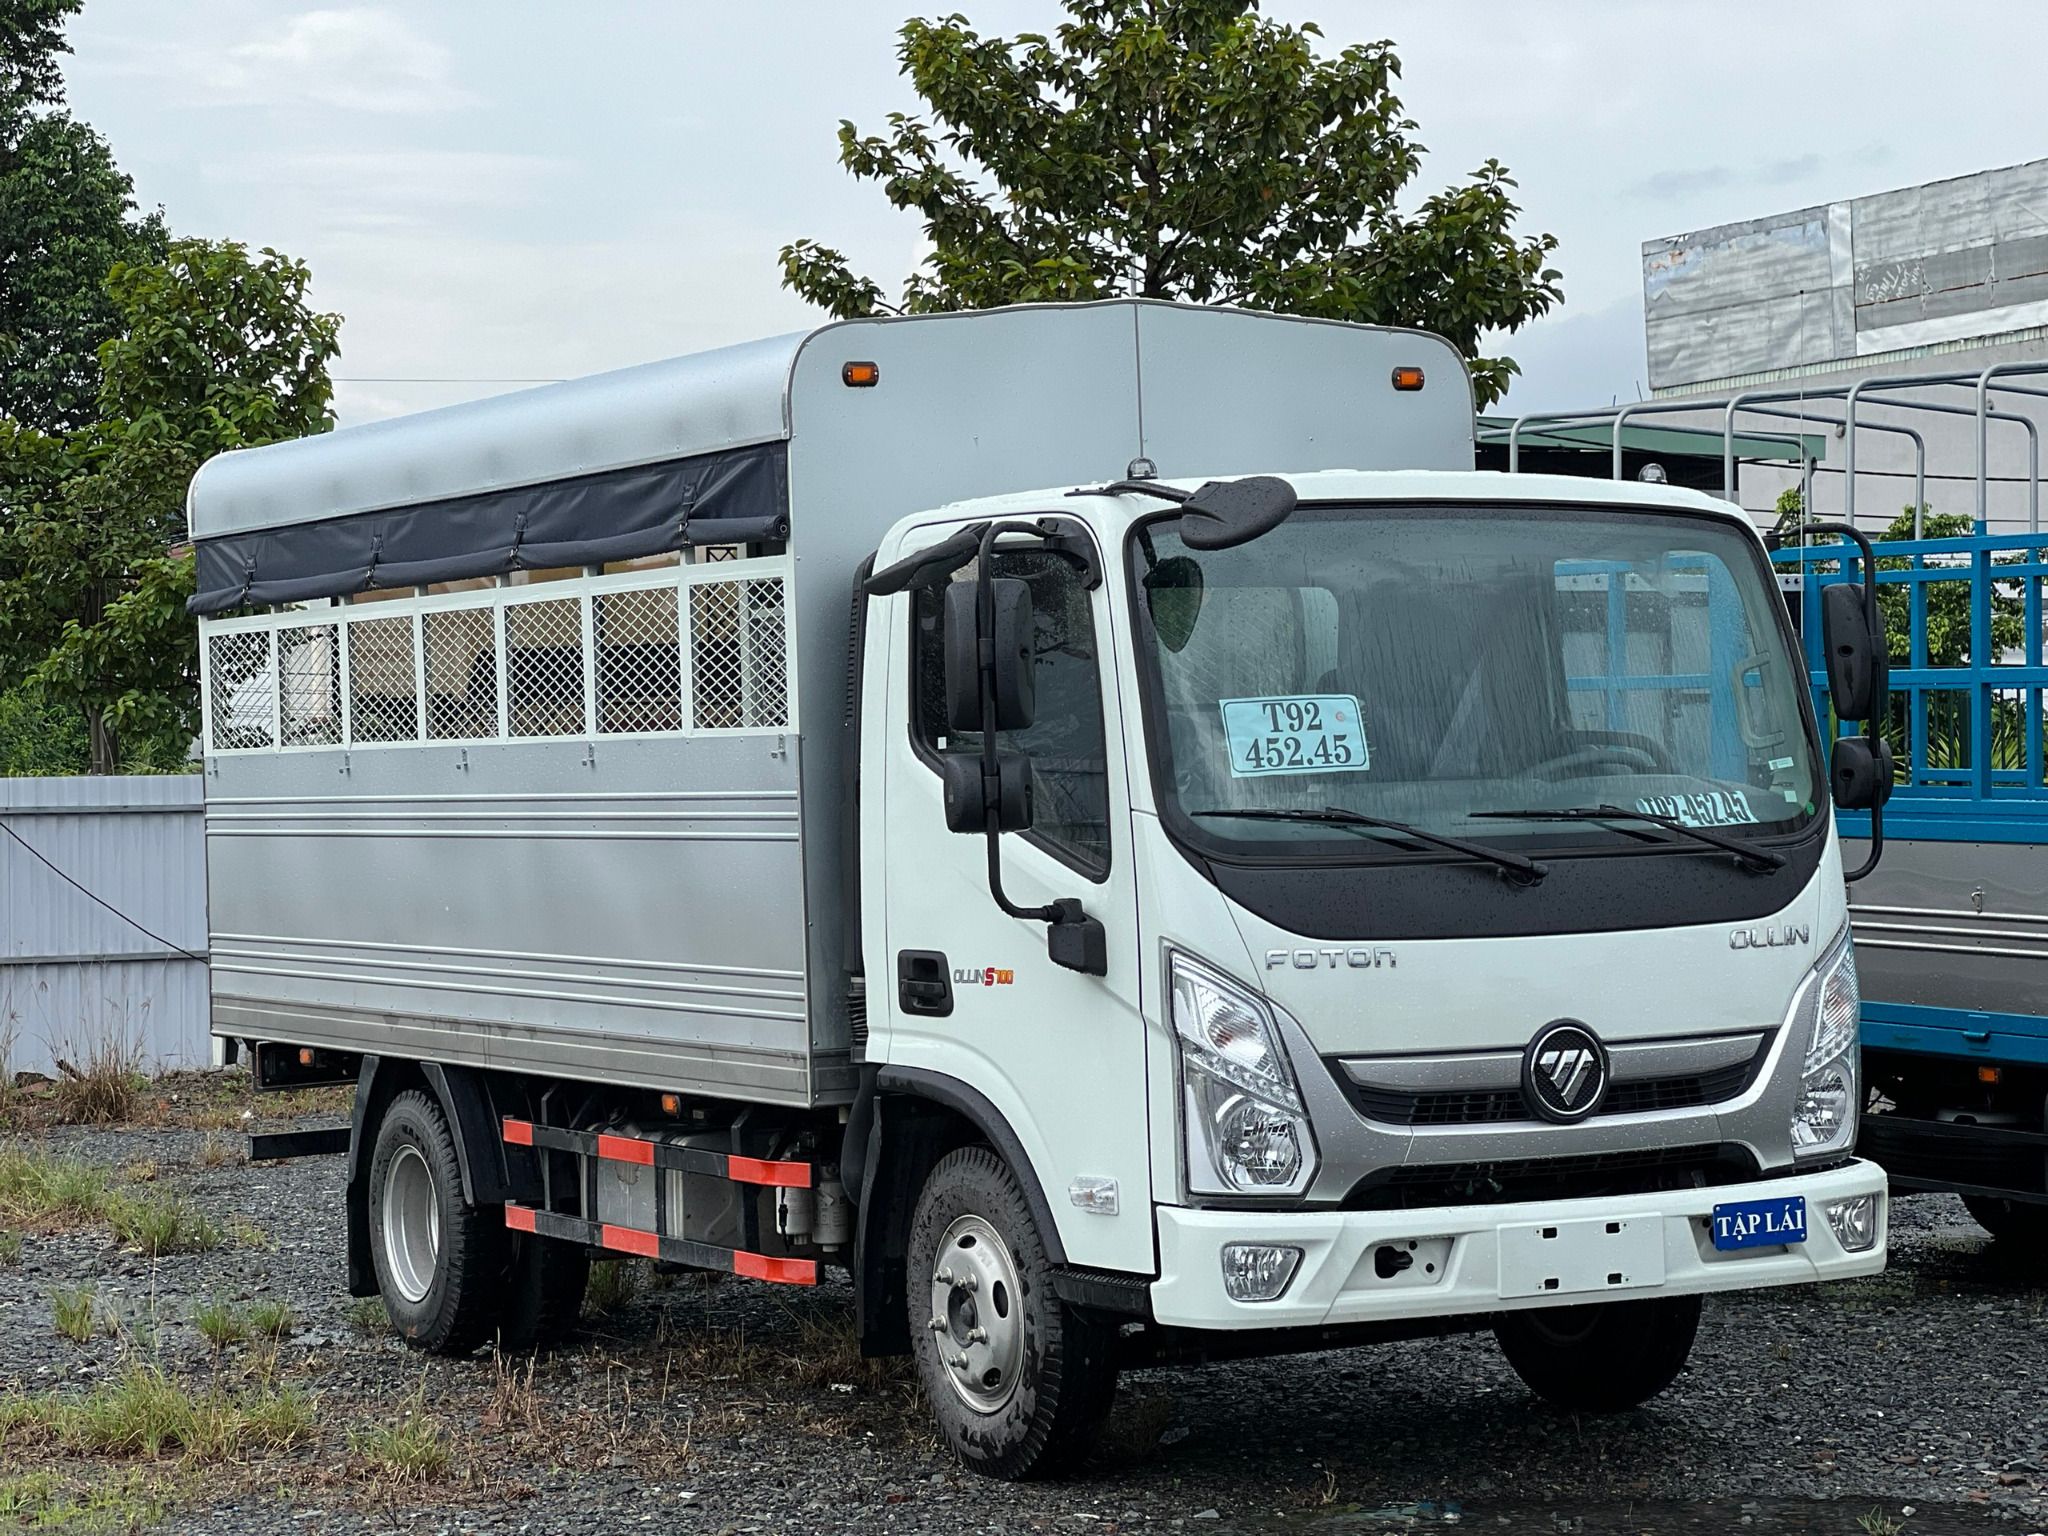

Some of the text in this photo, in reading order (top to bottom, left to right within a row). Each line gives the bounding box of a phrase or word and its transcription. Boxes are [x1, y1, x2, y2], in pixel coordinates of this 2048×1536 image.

[1262, 701, 1323, 733] T92
[1245, 733, 1352, 769] 452.45
[1729, 923, 1810, 950] OLLIN
[1717, 1204, 1805, 1241] TẬP LÁI
